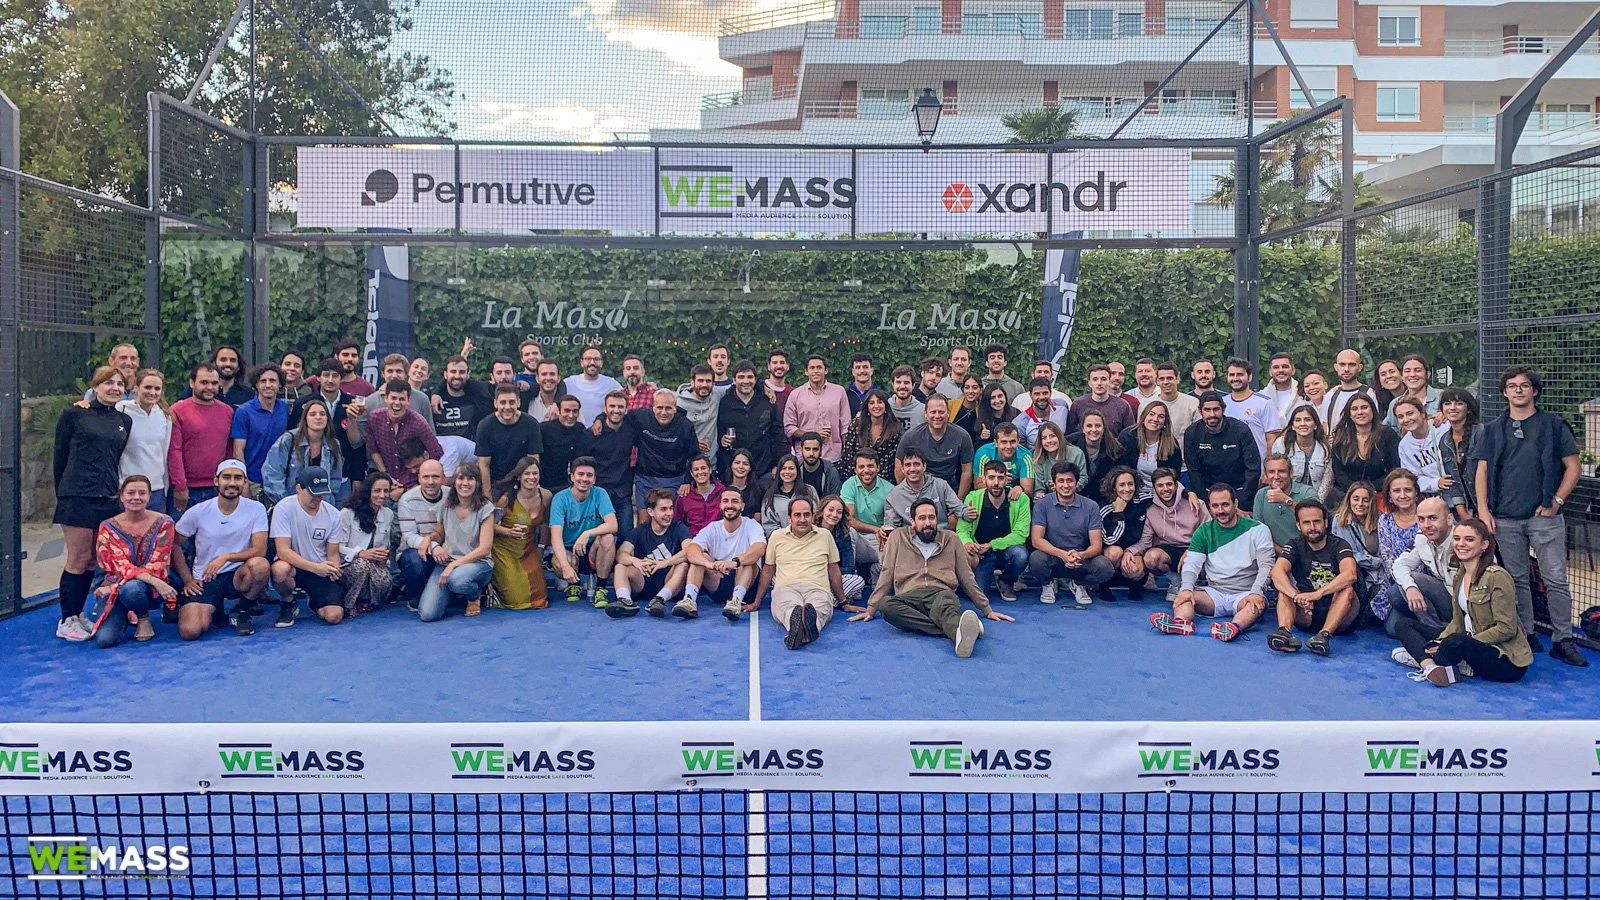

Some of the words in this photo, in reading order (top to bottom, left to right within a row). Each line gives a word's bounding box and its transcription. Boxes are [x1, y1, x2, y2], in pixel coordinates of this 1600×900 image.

[411, 172, 596, 206] Permutive
[660, 175, 857, 209] WEMASS
[976, 171, 1128, 213] xandr
[481, 300, 523, 329] La
[877, 303, 917, 331] La
[526, 333, 569, 347] Sports
[572, 333, 603, 346] Club
[920, 335, 962, 350] Sports
[965, 335, 997, 347] Club
[446, 407, 461, 420] 23
[219, 750, 365, 772] WEMASS
[452, 750, 596, 772] WEMASS
[682, 748, 824, 770] WEMASS
[910, 748, 1052, 770] WEMASS
[1138, 748, 1280, 770] WEMASS
[1366, 748, 1508, 770] WEMASS
